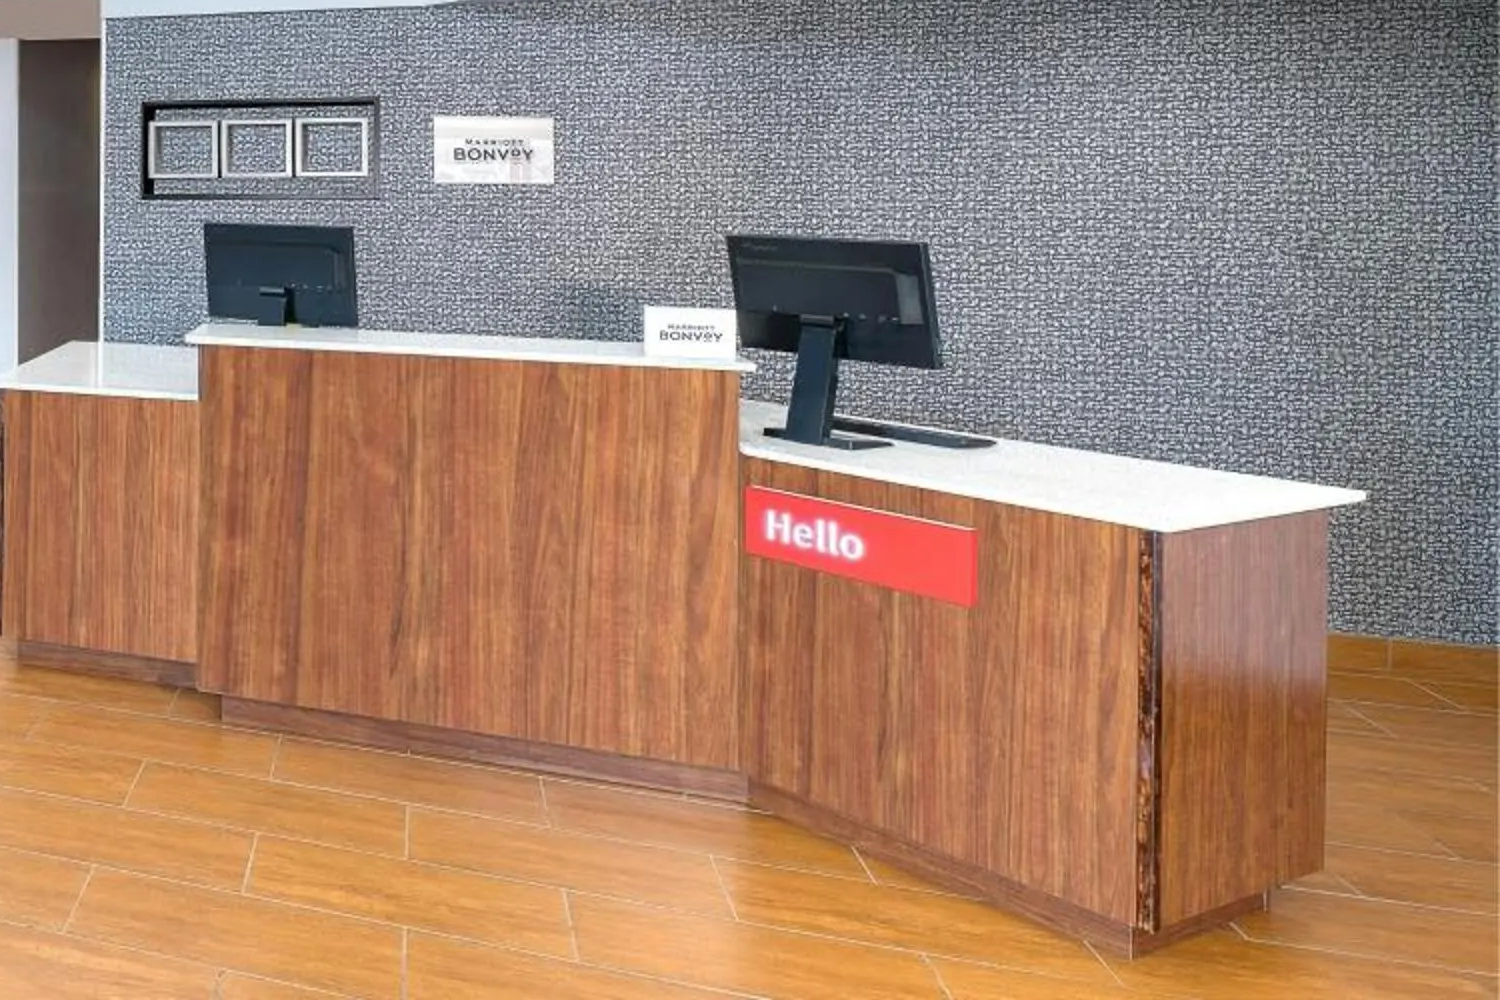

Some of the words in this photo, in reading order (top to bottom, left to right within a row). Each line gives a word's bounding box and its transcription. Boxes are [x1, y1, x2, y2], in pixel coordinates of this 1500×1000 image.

[453, 147, 533, 161] BONVOY
[659, 330, 723, 342] BONVOY
[765, 509, 865, 560] Hello
